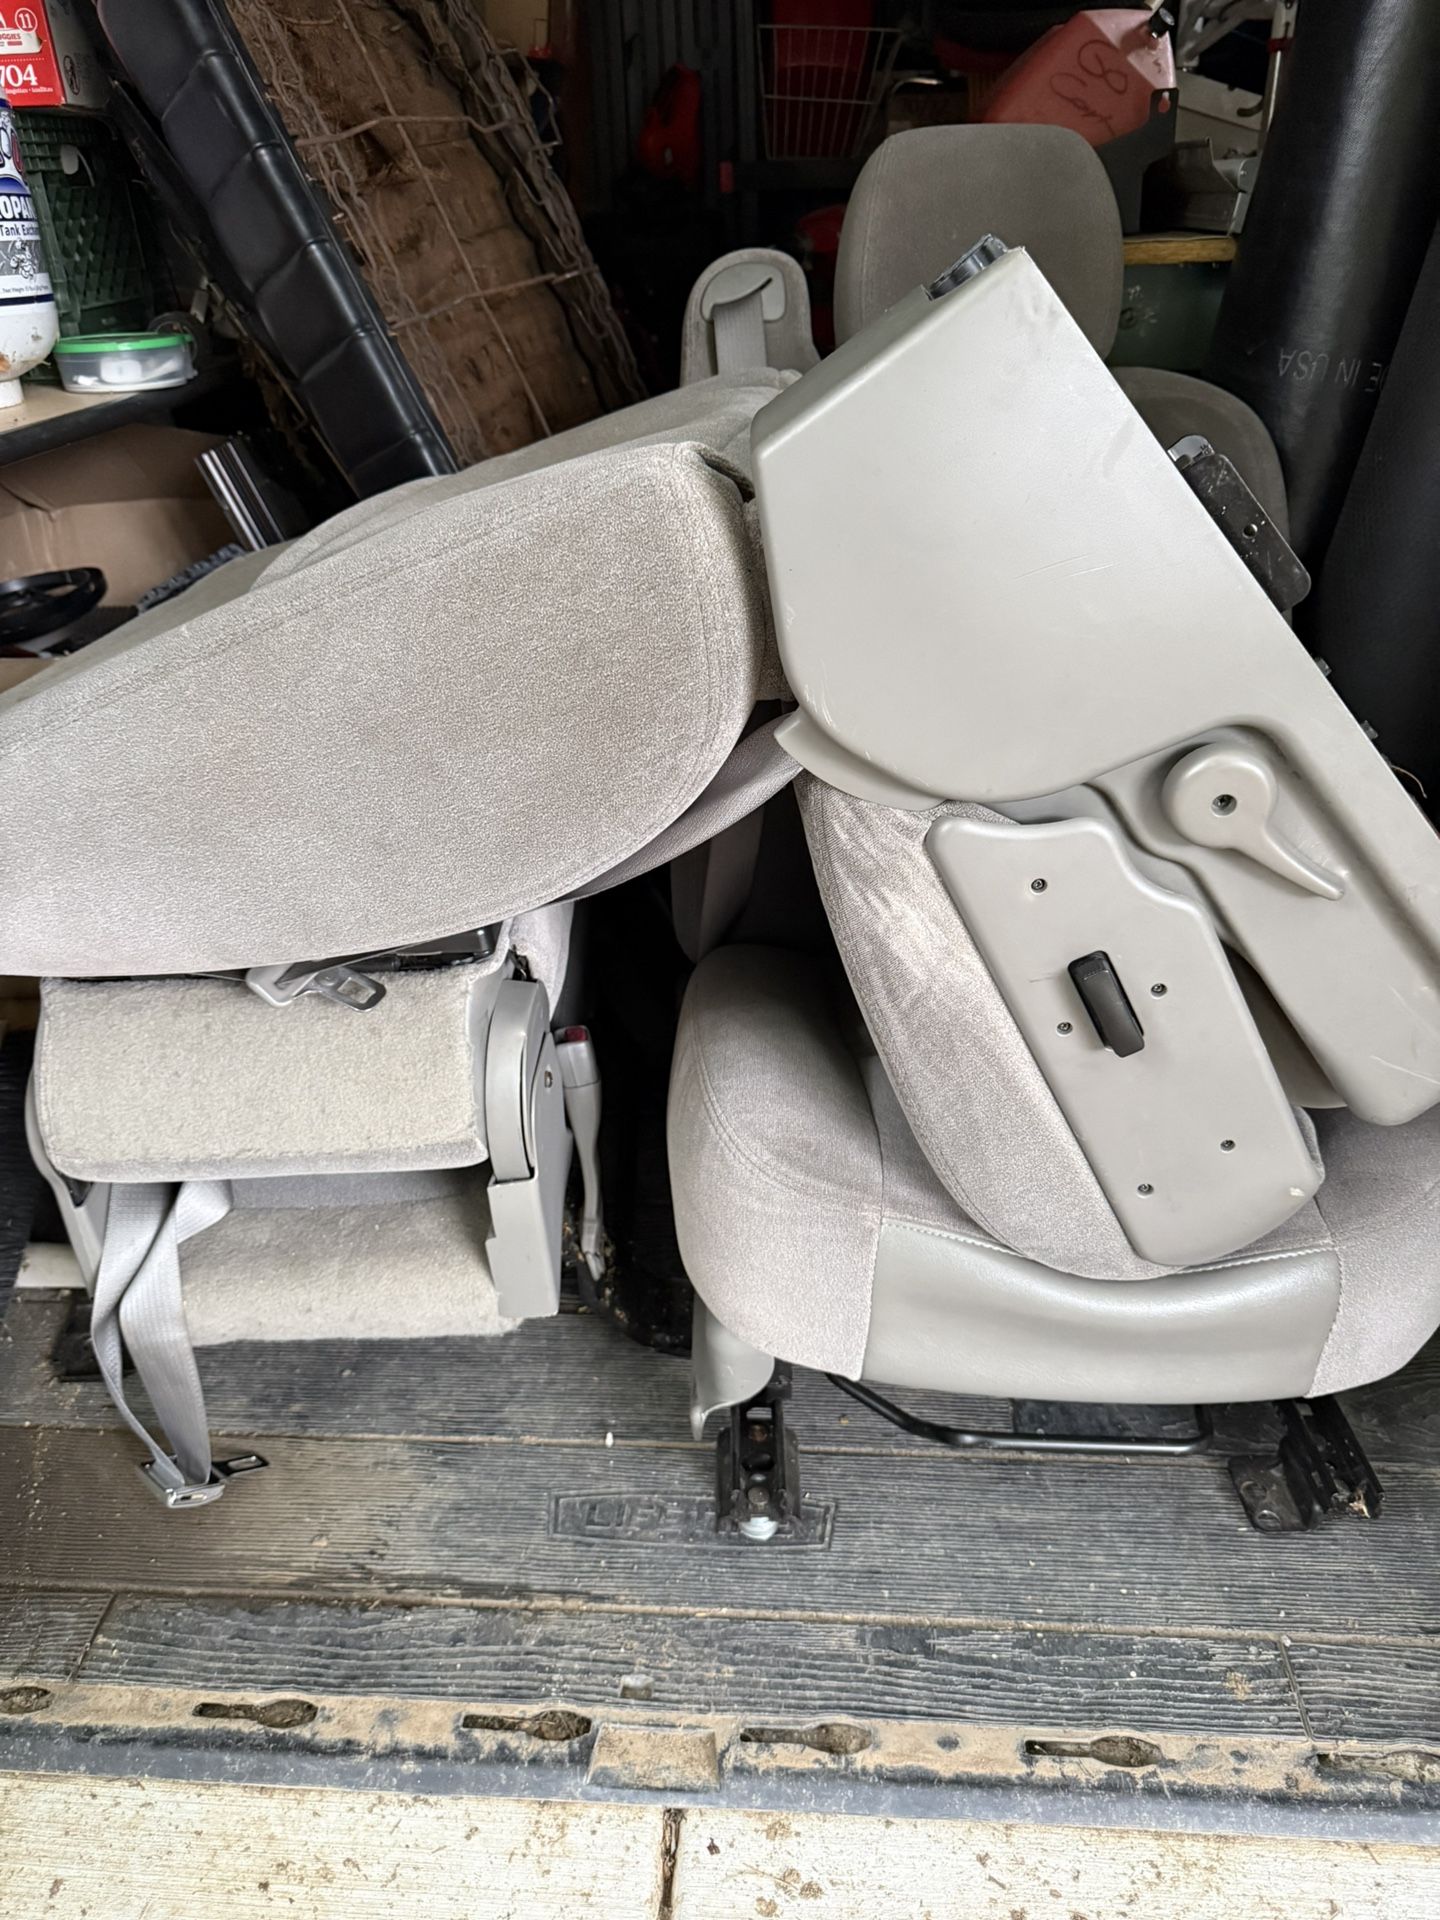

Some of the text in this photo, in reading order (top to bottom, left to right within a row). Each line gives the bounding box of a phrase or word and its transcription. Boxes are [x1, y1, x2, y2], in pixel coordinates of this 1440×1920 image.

[18, 13, 33, 28] 11
[0, 64, 38, 88] 704
[0, 195, 37, 220] OPAN
[0, 224, 20, 237] Tank
[1278, 348, 1330, 381] USA
[1334, 357, 1361, 386] IN
